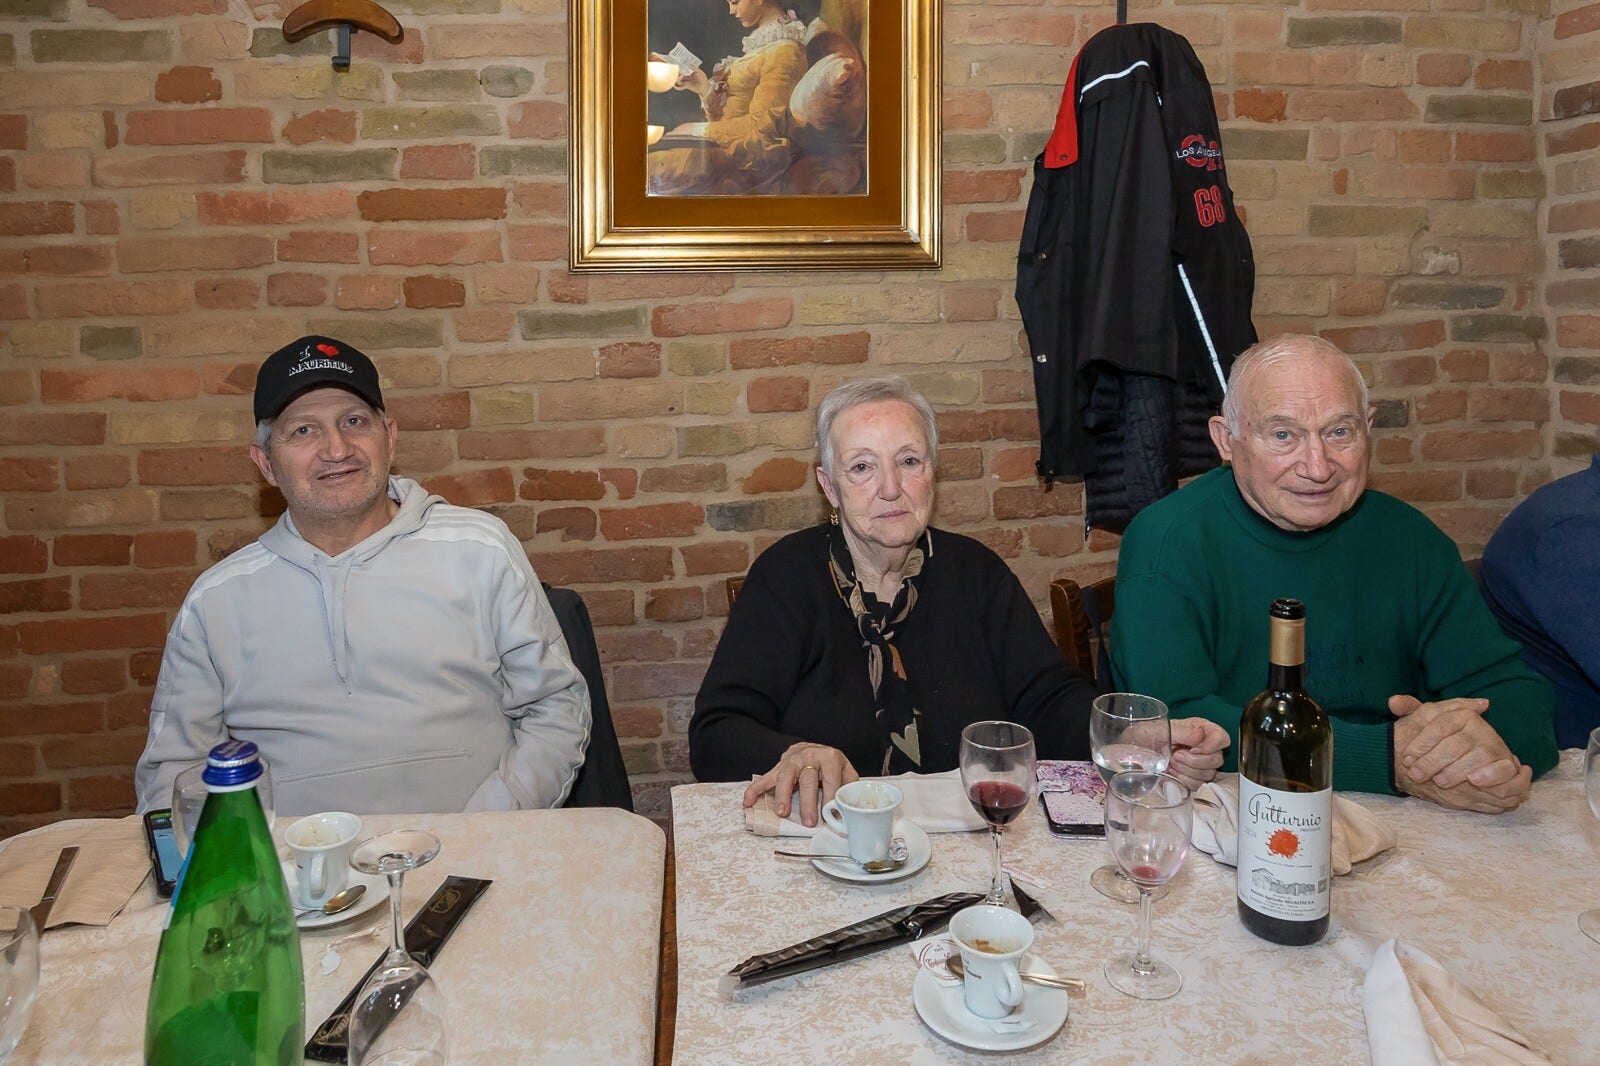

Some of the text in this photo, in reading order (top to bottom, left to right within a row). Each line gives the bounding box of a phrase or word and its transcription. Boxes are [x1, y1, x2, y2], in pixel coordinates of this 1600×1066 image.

[1176, 147, 1195, 158] LOS
[1194, 185, 1226, 227] 68
[288, 359, 354, 377] MAURITIUS
[1248, 792, 1322, 827] Gutturnio
